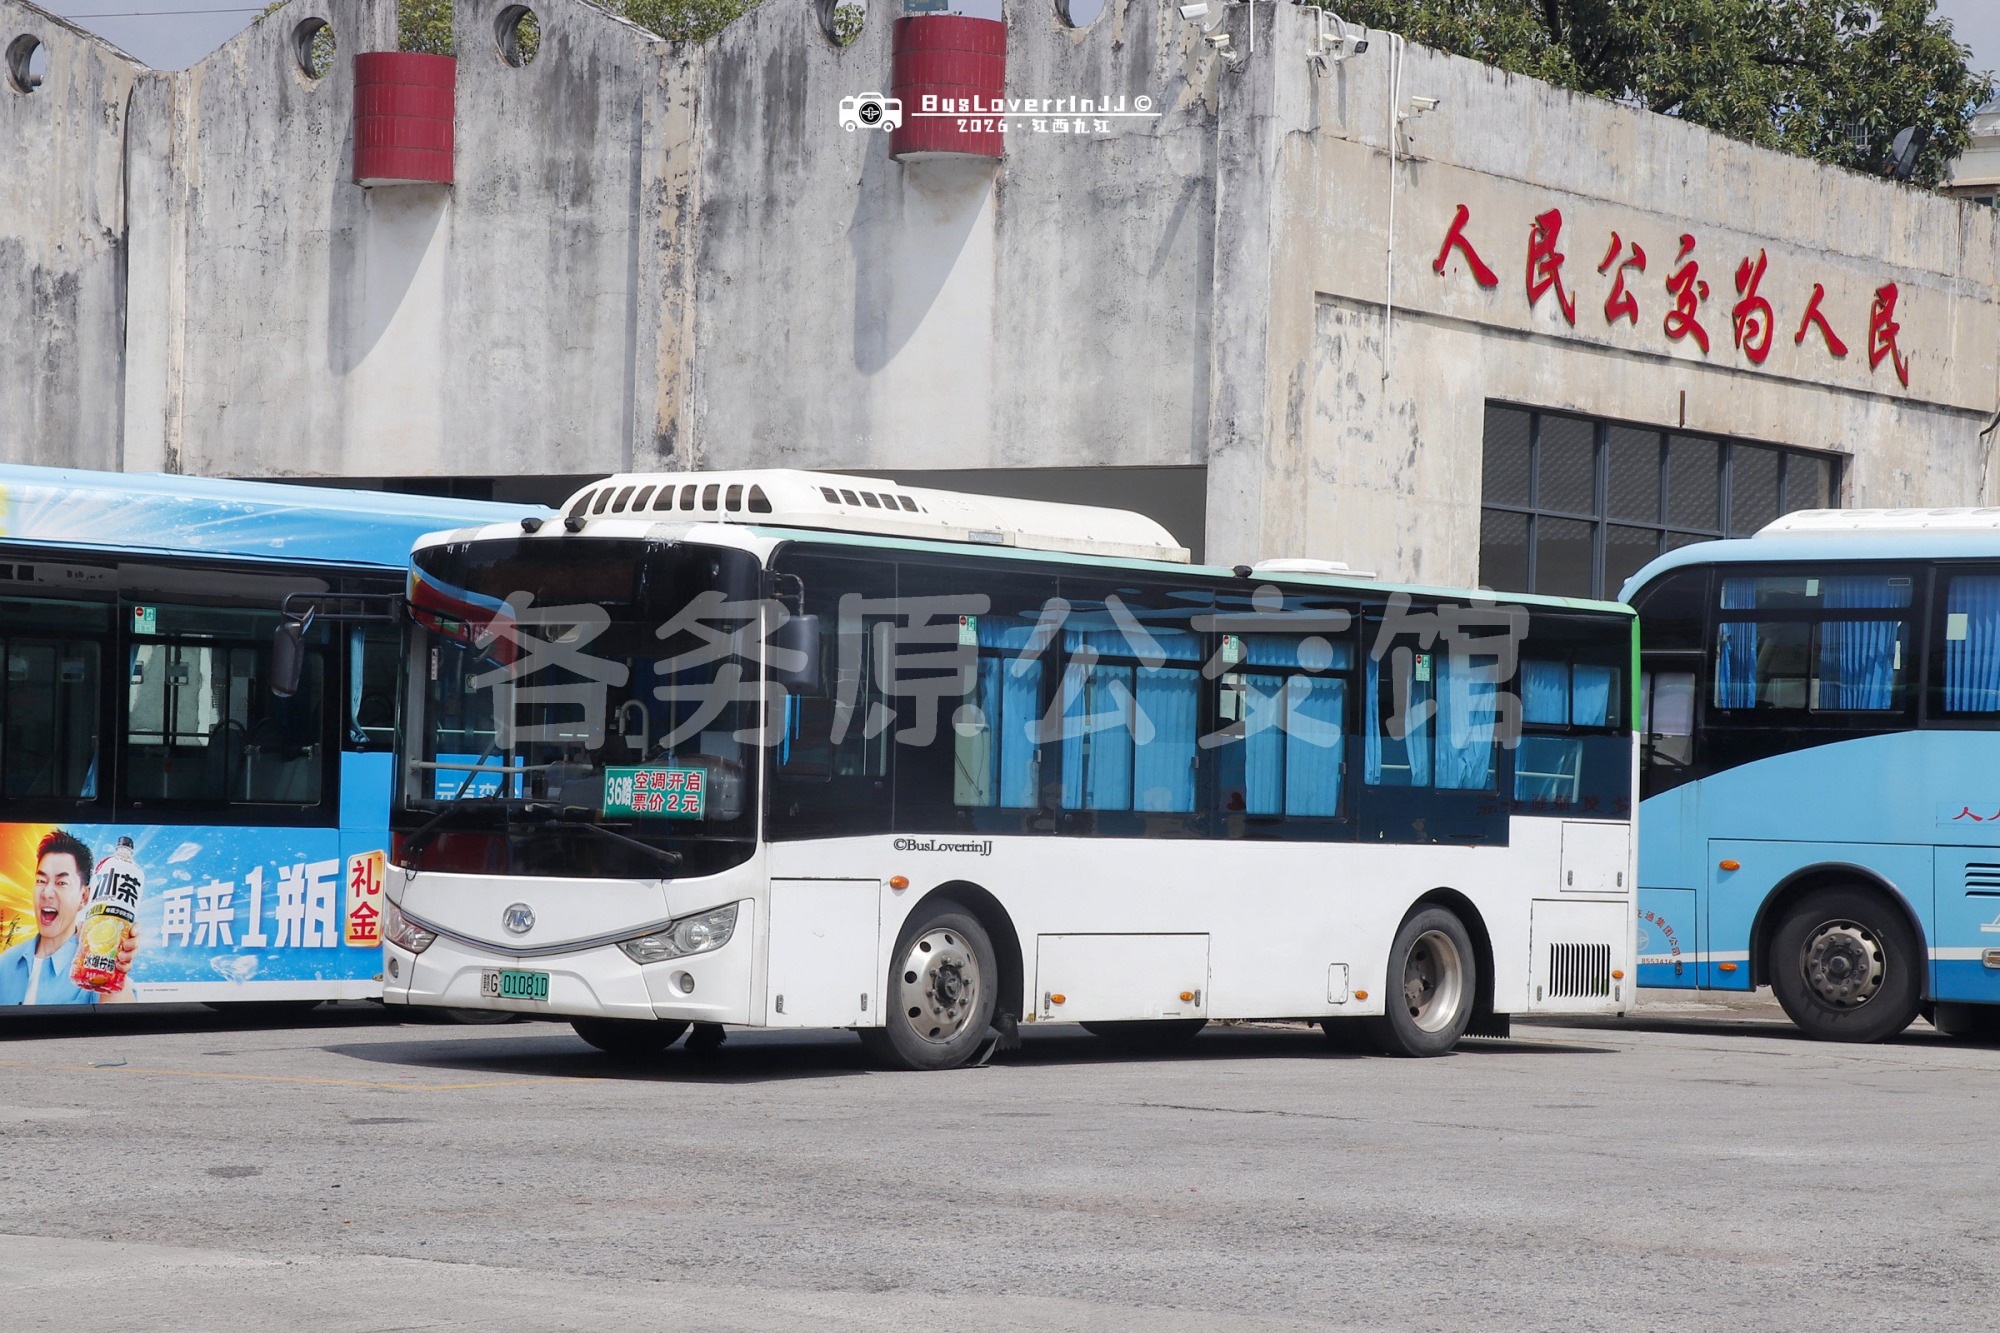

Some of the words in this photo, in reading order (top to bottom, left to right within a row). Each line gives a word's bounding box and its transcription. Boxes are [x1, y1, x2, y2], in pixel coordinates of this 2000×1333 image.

[1433, 204, 1909, 388] 人民公交为人民
[607, 777, 632, 807] 36路
[634, 771, 702, 792] 空调开启
[631, 792, 700, 813] 票价2元
[92, 867, 141, 908] 冰茶
[161, 858, 340, 948] 再来1瓶
[349, 857, 381, 941] 礼金
